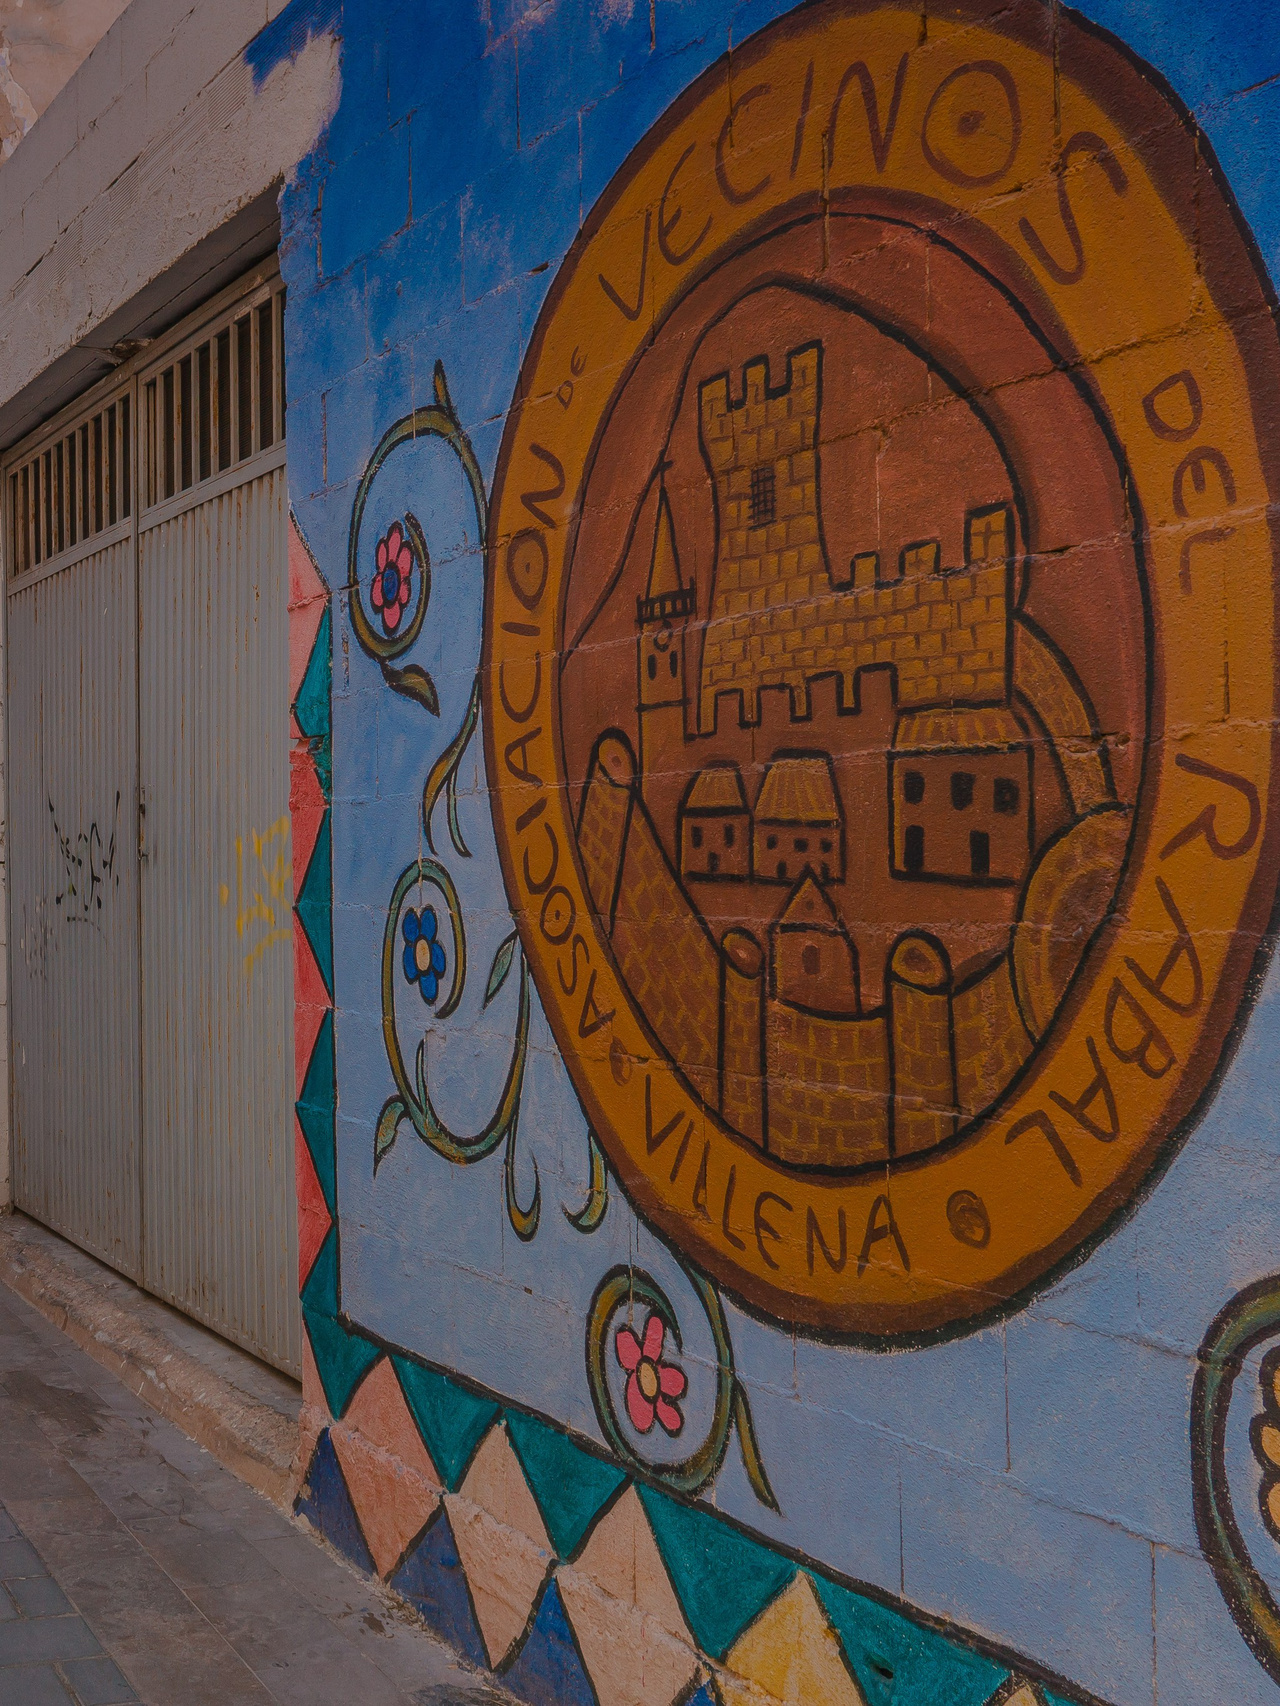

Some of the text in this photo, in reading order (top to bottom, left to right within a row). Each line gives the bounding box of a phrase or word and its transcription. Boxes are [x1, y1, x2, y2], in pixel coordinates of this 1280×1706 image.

[498, 52, 1261, 1188] ASOCIACION DE VECINOS DEL RABAL
[645, 1073, 911, 1278] VILLENA
